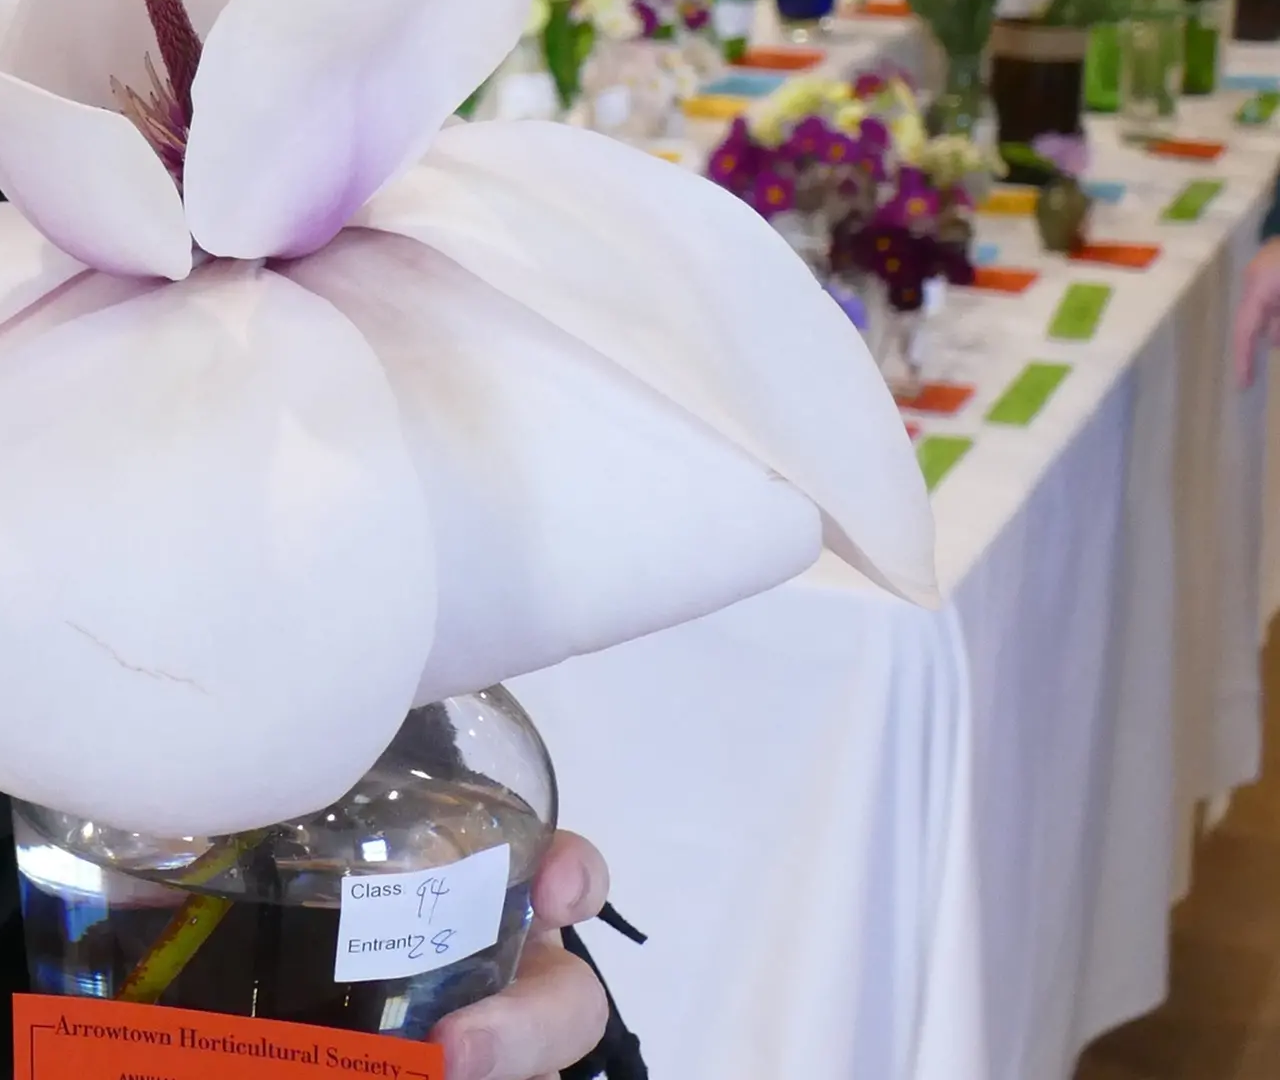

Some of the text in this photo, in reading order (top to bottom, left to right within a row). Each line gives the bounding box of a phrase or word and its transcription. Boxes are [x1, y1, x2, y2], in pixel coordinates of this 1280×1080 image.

[348, 929, 458, 959] Entrant 28
[54, 1014, 402, 1080] Arrowtown Horticultural Society
